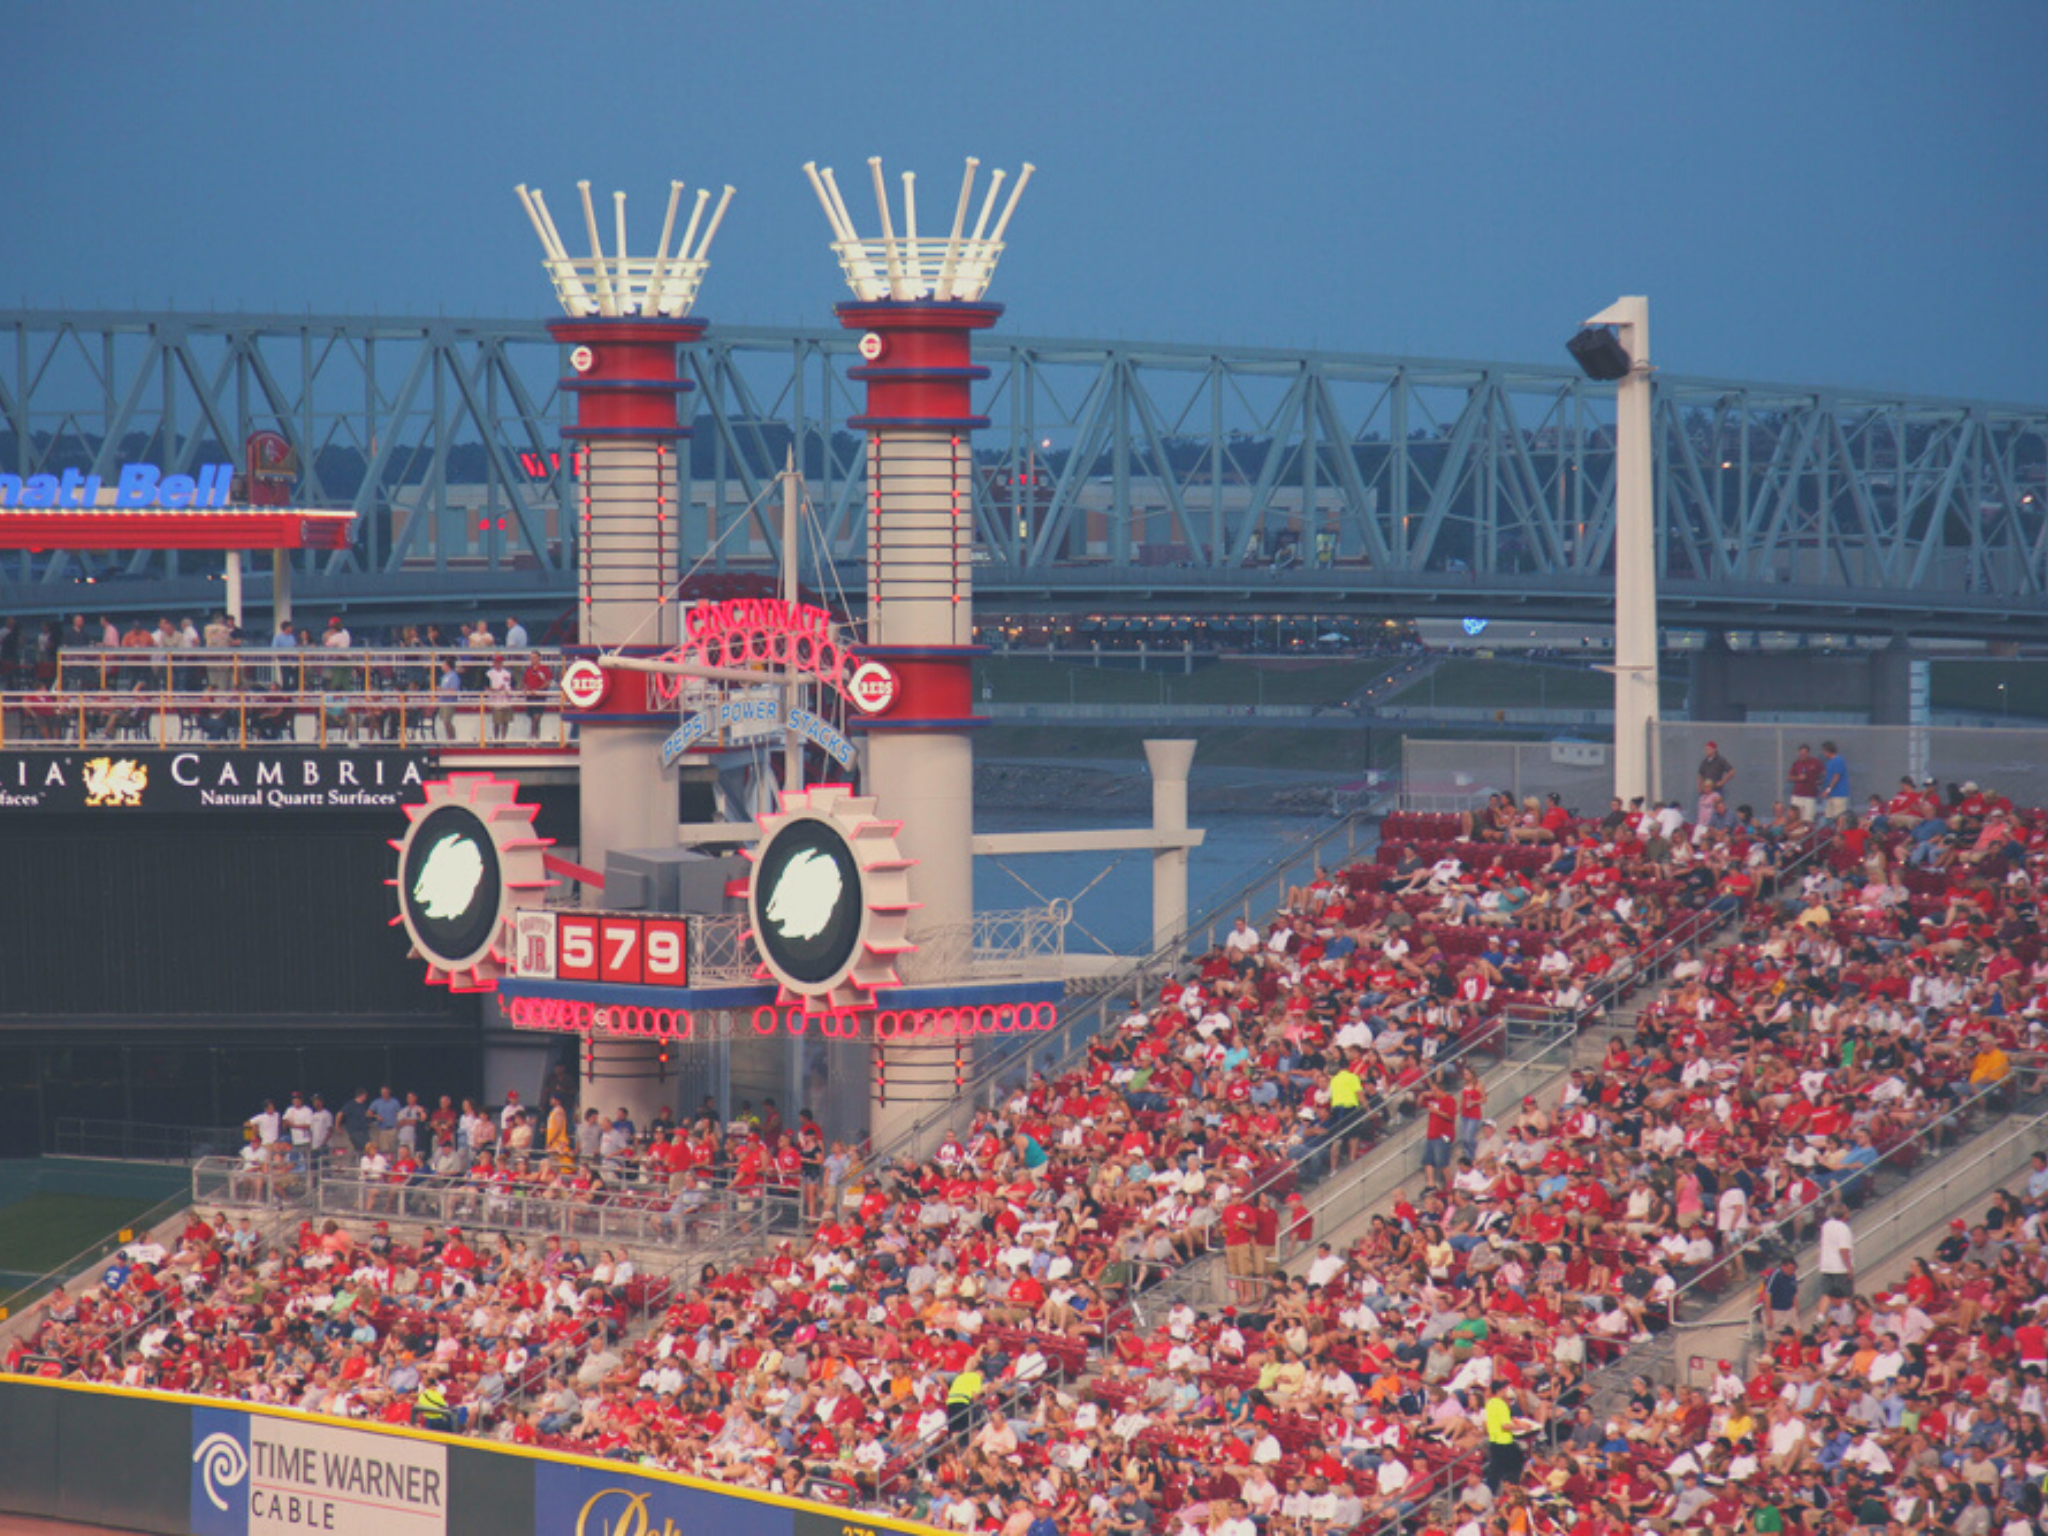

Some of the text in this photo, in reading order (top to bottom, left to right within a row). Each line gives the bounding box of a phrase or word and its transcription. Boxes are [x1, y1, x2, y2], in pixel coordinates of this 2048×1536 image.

[116, 463, 234, 507] Bell
[685, 597, 831, 641] CINCINNATI
[663, 701, 852, 765] PEPSI POWER STACKS
[170, 752, 422, 787] CAMBRIA
[201, 789, 396, 808] Natural Quartz Surfaces
[562, 924, 680, 974] 579
[252, 1440, 442, 1507] TIME WARNER
[251, 1490, 335, 1530] CABLE
